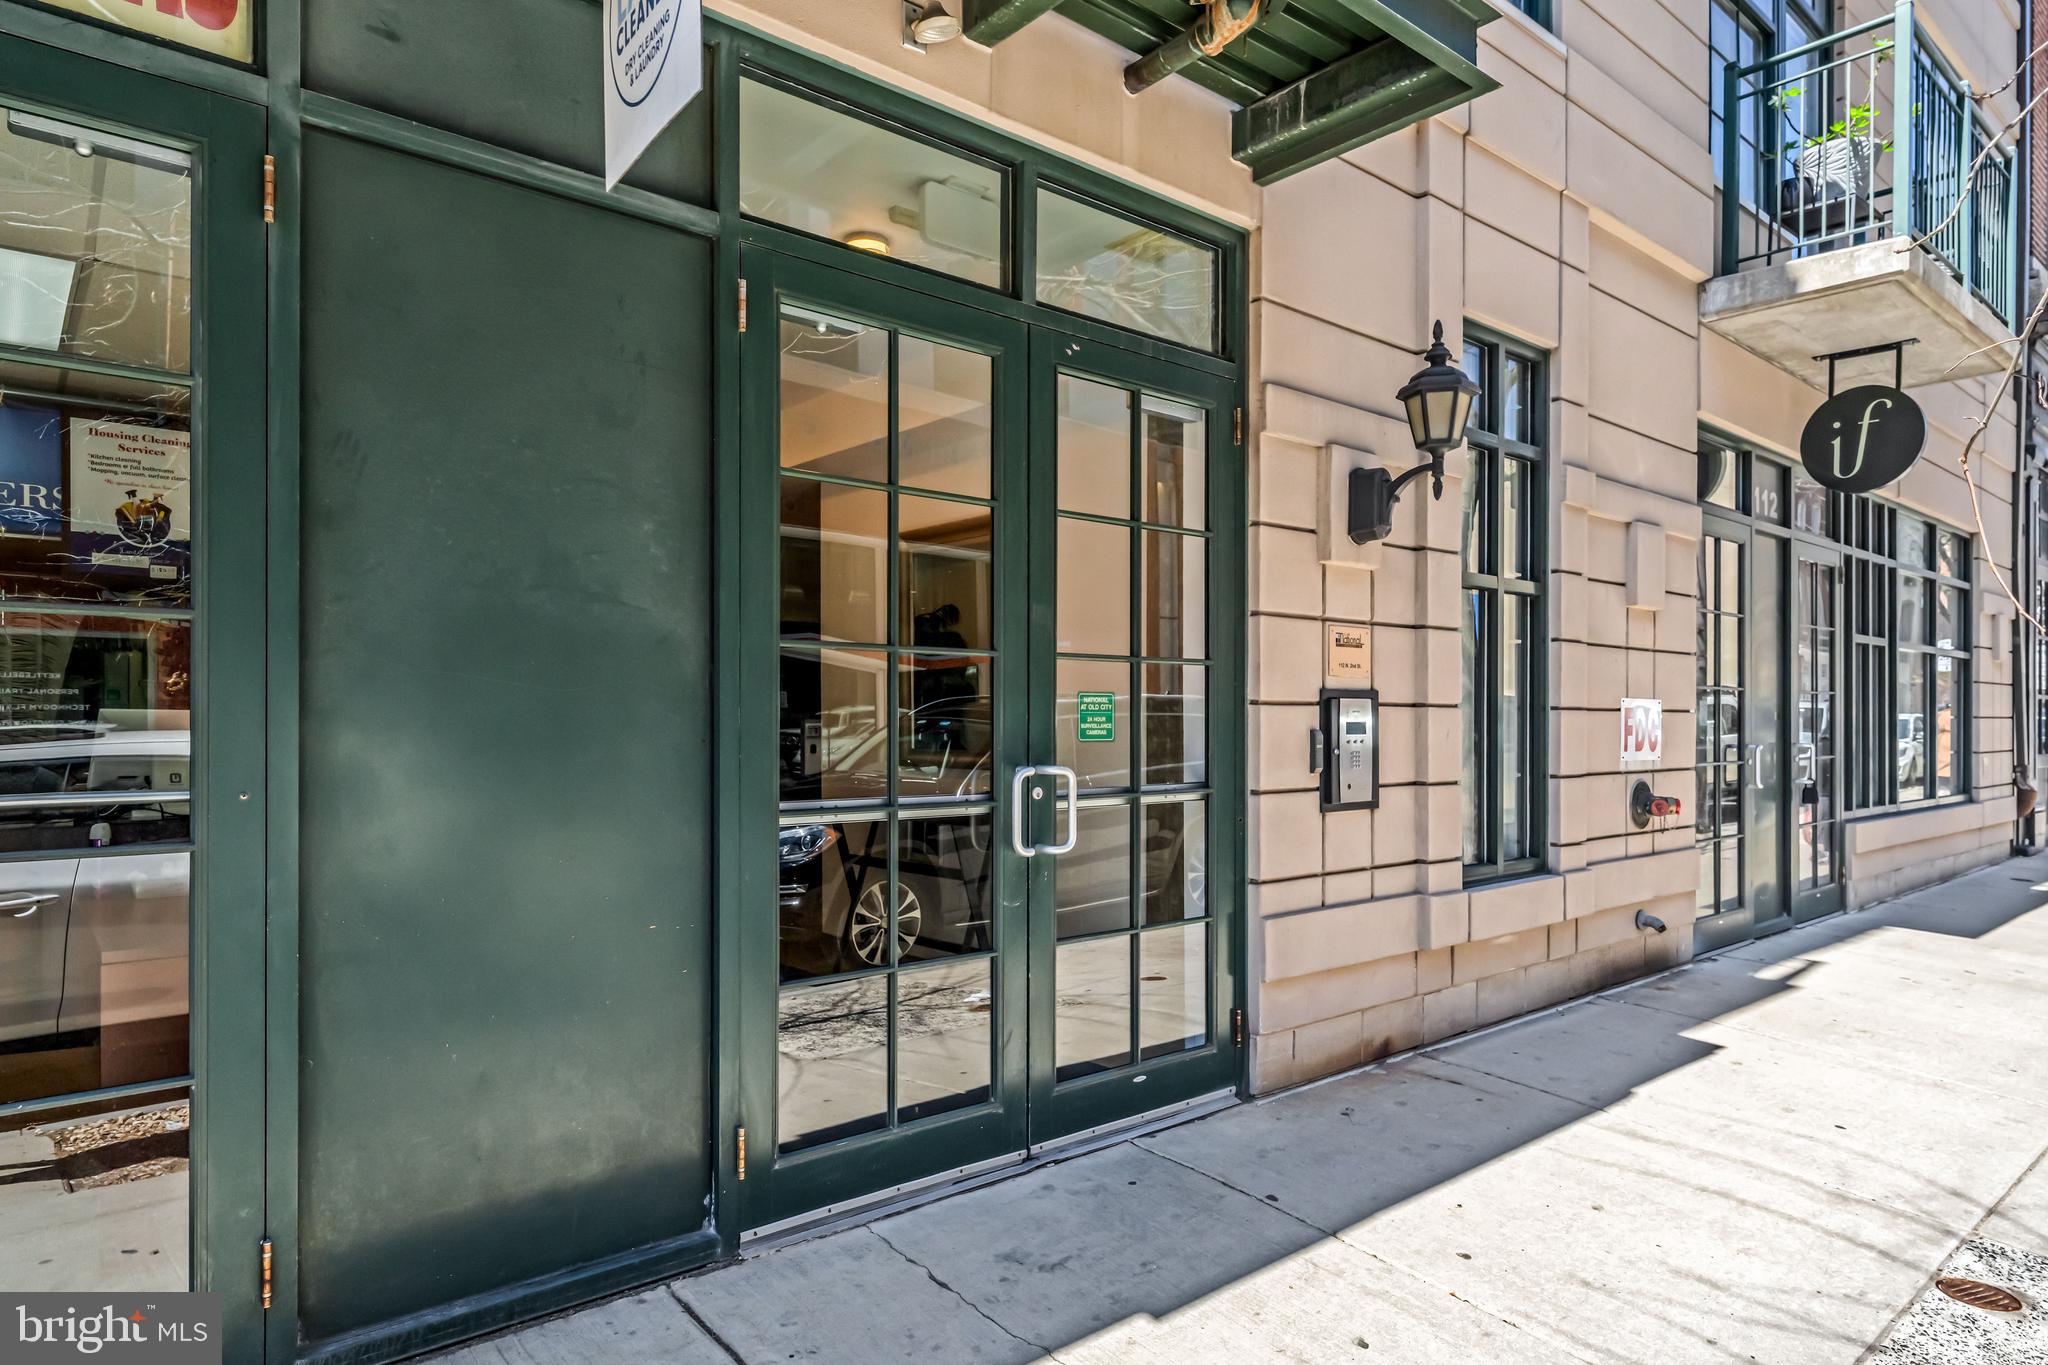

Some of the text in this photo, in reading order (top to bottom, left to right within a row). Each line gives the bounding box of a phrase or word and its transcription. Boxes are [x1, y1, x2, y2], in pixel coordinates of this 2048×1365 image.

[616, 0, 663, 56] CLEAN
[625, 51, 637, 76] DRY
[637, 9, 670, 58] CLEANING
[629, 33, 665, 87] & LAUNDRY
[88, 427, 139, 443] Housing
[118, 442, 166, 457] Services
[1830, 398, 1893, 479] if
[114, 456, 141, 466] cleaning
[1754, 486, 1778, 519] 112
[1624, 705, 1660, 752] FDC
